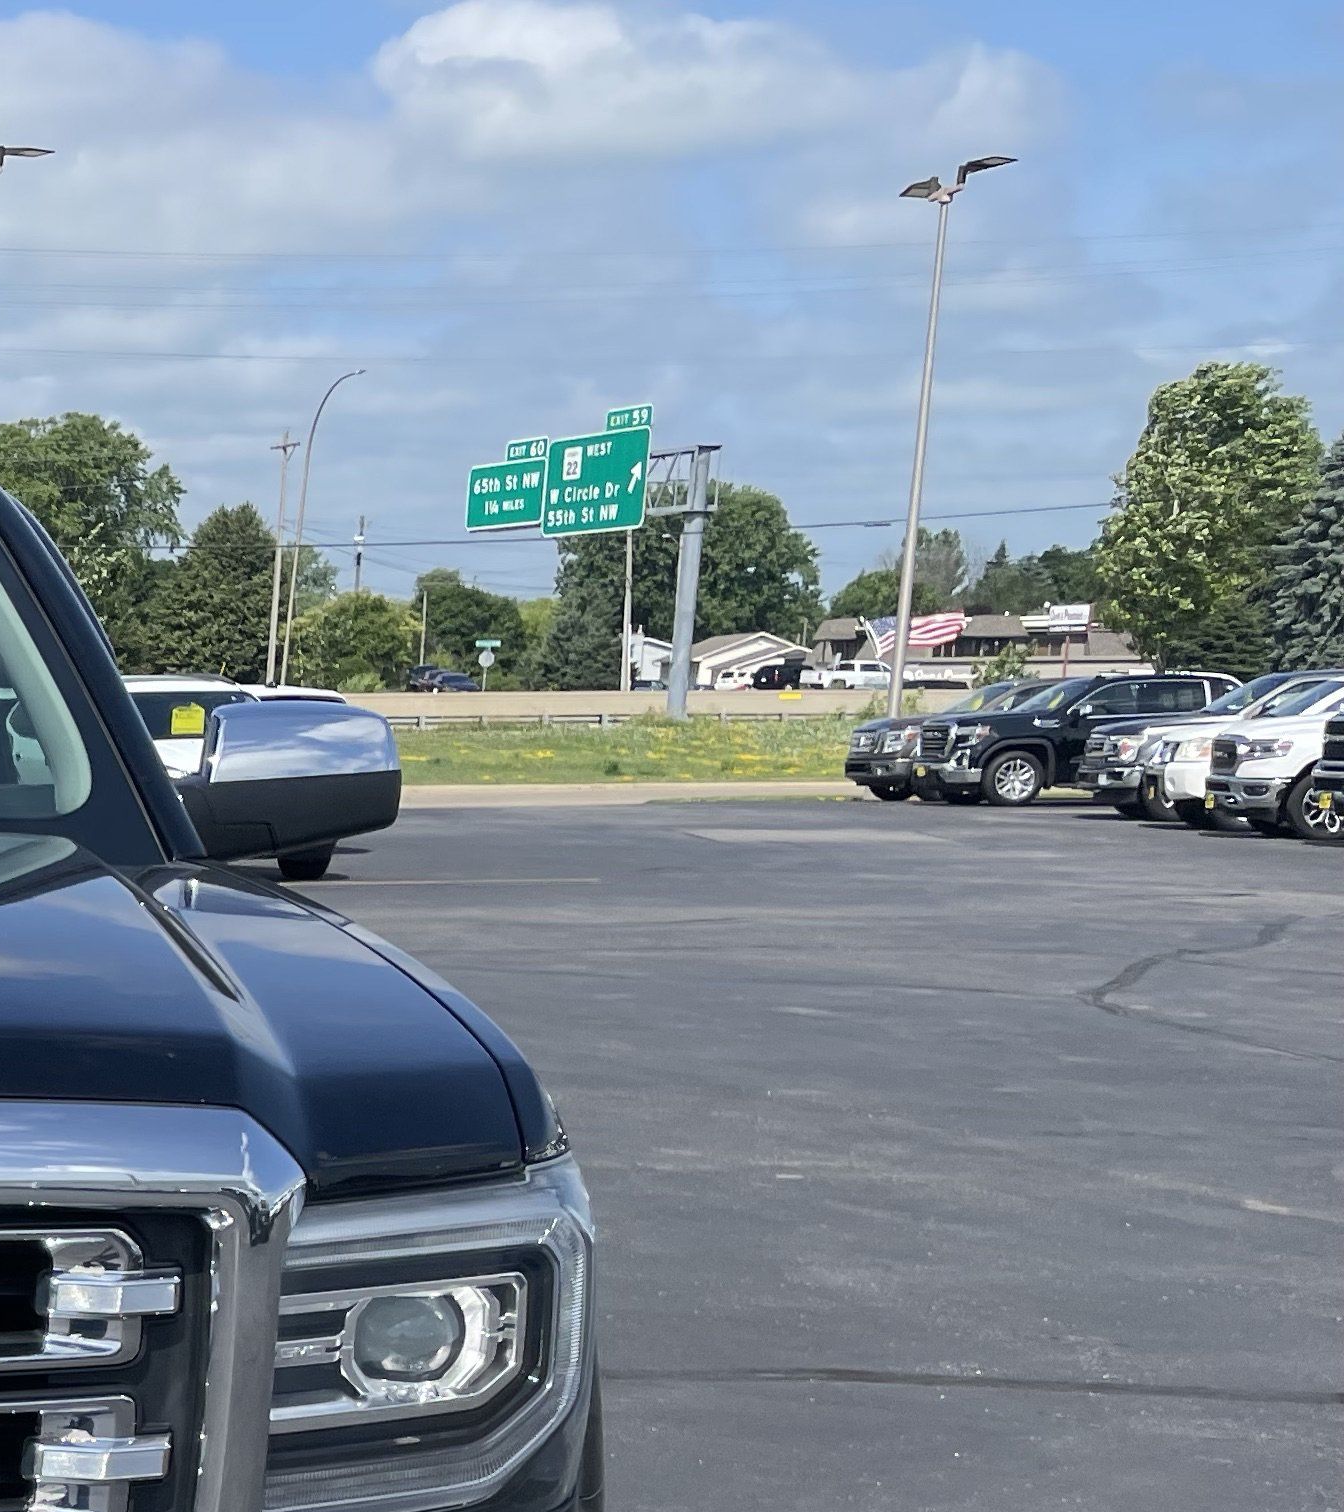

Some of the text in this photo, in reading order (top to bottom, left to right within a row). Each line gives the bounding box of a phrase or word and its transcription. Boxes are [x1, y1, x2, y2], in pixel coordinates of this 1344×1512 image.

[609, 408, 649, 427] EXIT 59
[509, 440, 545, 458] EXIT 60
[586, 441, 613, 457] WEST
[566, 460, 579, 476] 22
[473, 471, 541, 495] 65th St NW
[550, 481, 621, 505] W Circle Dr
[502, 498, 525, 512] MILES
[546, 503, 619, 527] 55th St NW
